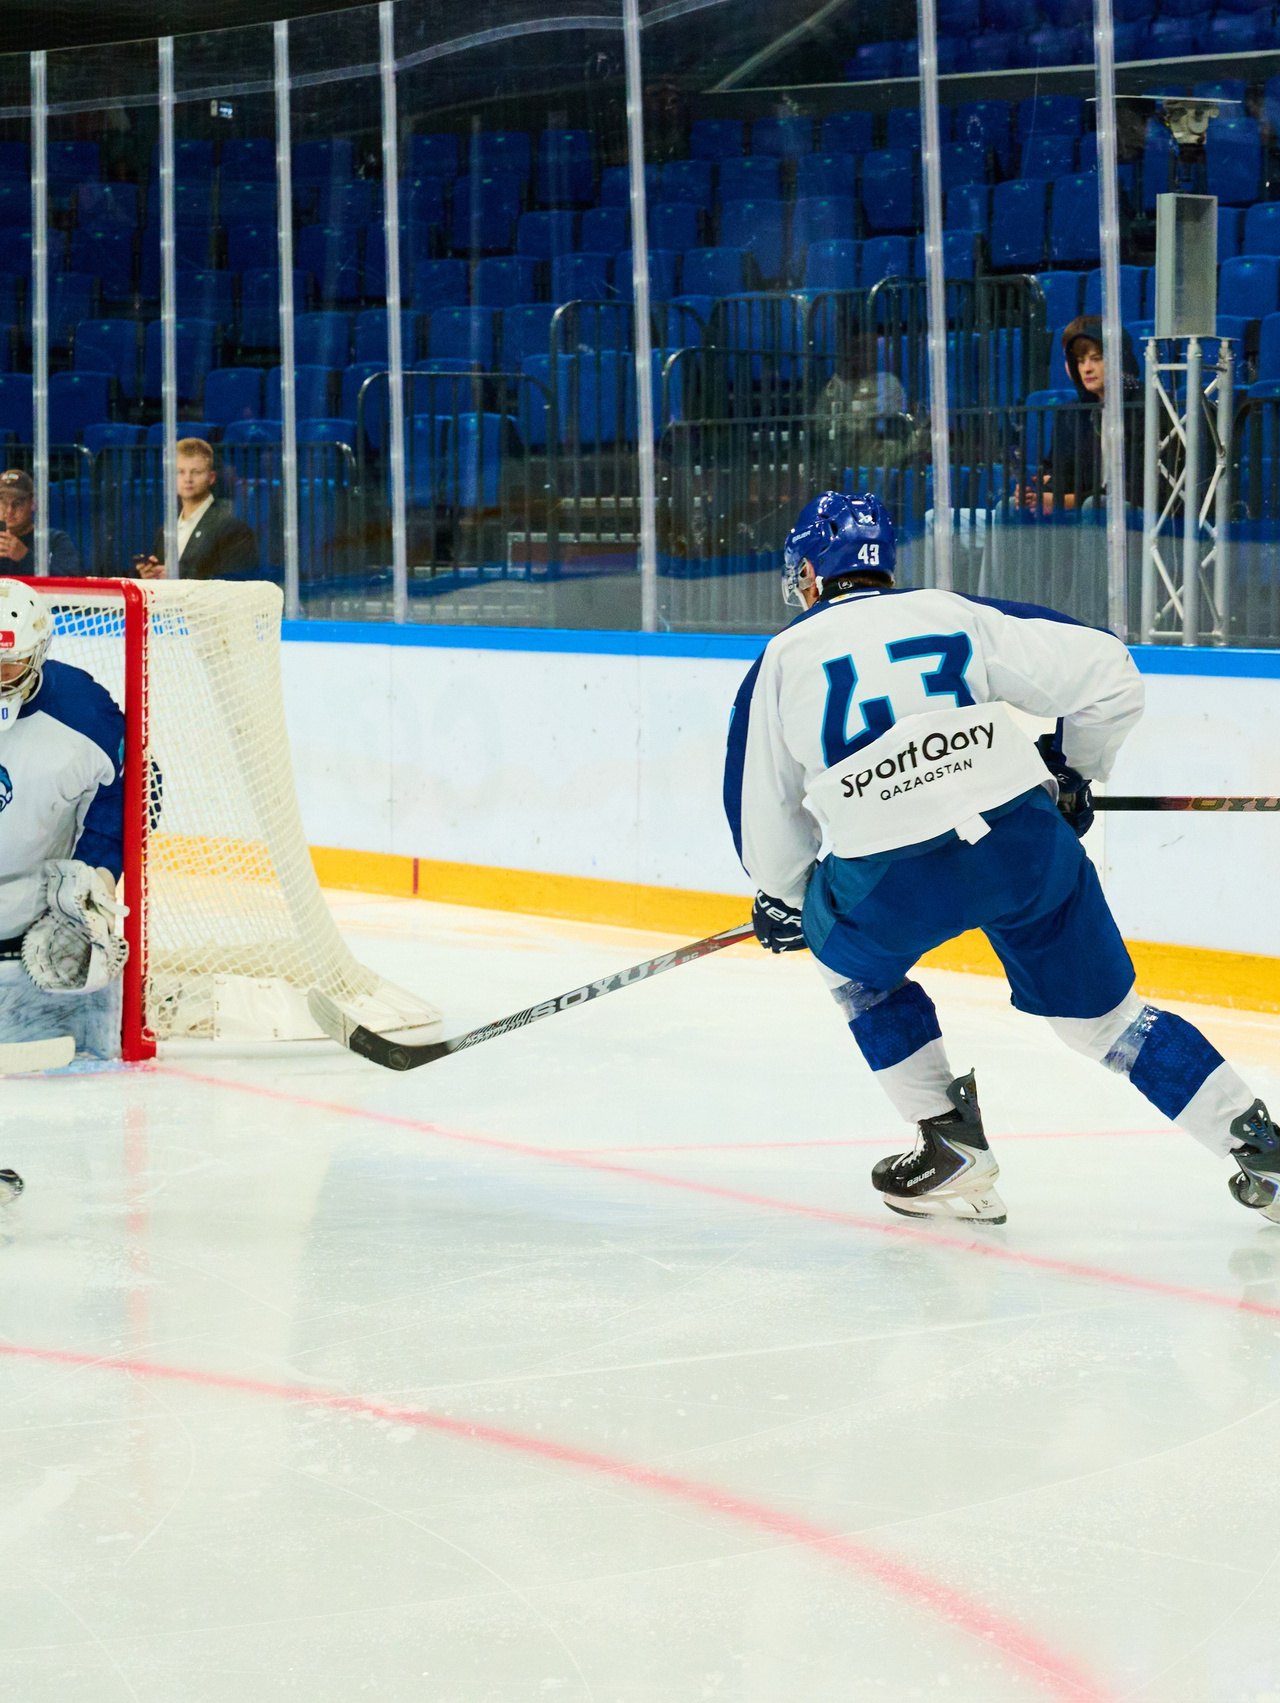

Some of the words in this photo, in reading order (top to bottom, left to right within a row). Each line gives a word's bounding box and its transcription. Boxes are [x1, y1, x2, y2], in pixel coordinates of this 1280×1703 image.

[857, 543, 880, 566] 43
[821, 631, 977, 769] 43
[880, 758, 973, 800] QAZAQSTAN
[530, 951, 678, 1021] SOYUZ
[906, 1167, 936, 1188] BAUER
